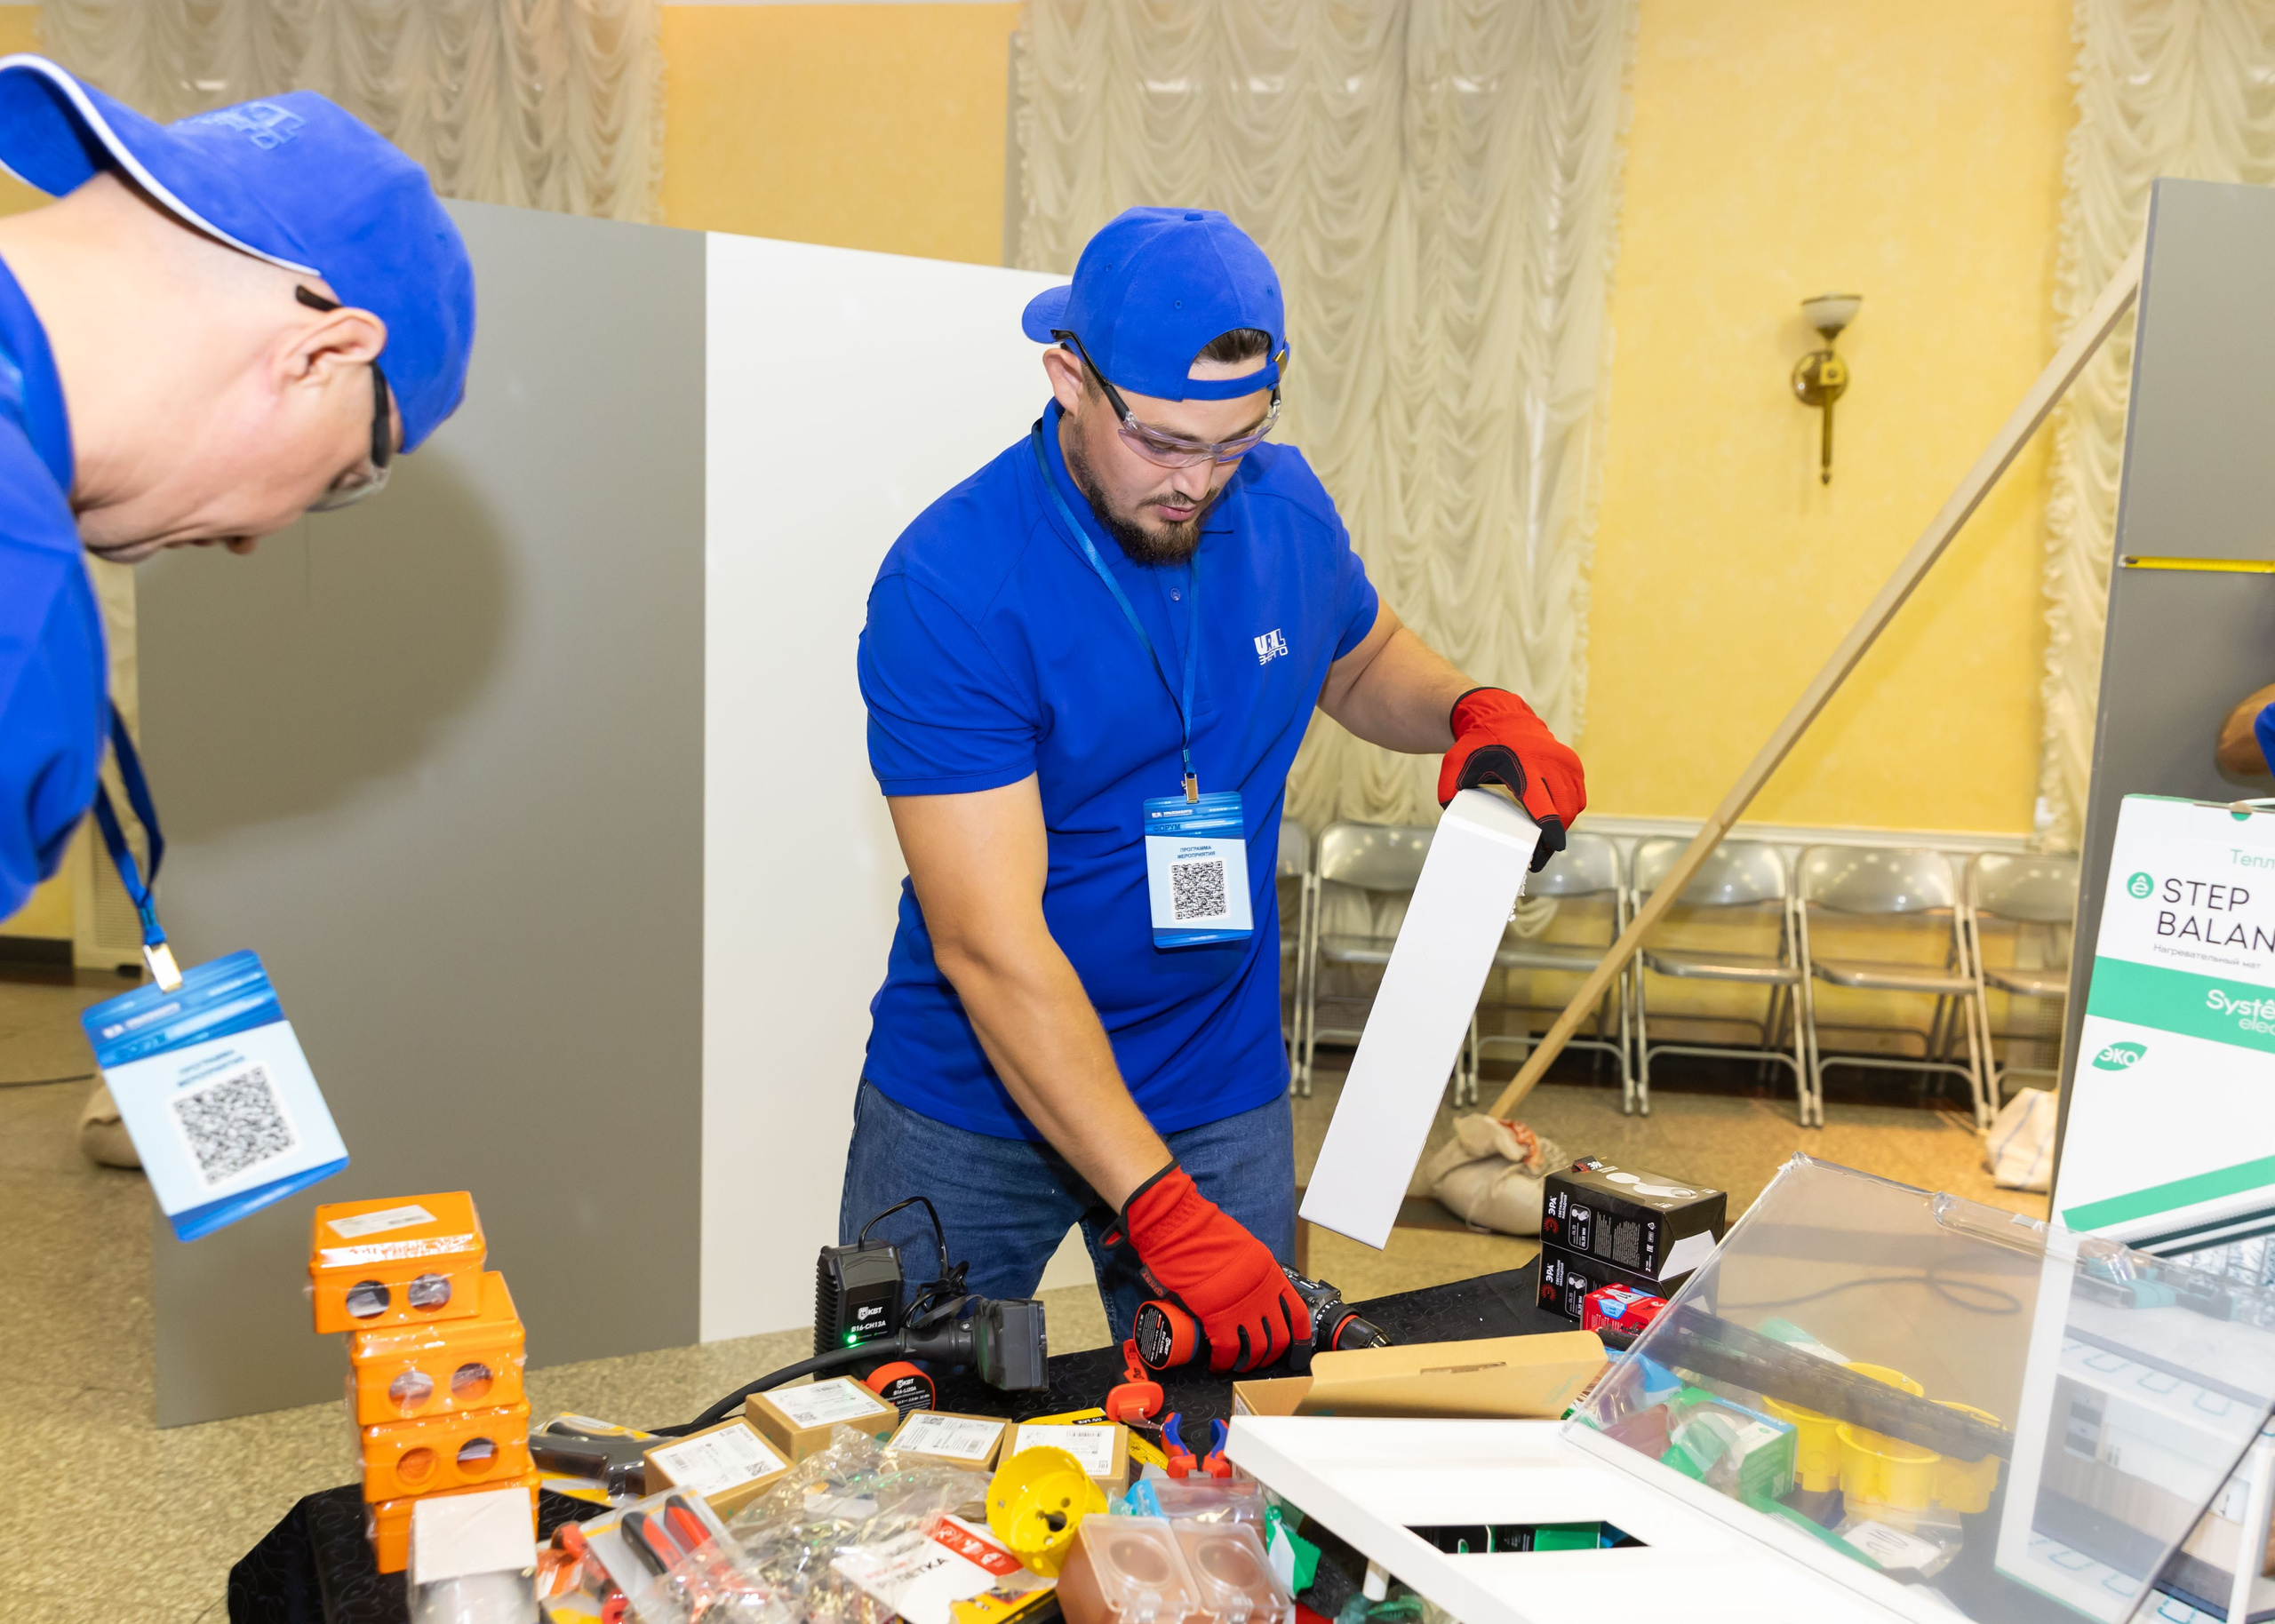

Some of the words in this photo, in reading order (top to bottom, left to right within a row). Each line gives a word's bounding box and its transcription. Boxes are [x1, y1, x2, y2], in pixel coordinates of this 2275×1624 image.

[2230, 848, 2275, 869] Тепл
[2162, 878, 2250, 912] STEP
[2157, 911, 2275, 953] BALAN
[2153, 943, 2239, 966] Нагревательный
[2098, 1046, 2138, 1066] ЭКО
[1548, 1197, 1557, 1216] ЭРА
[1545, 1264, 1554, 1283] ЭРА
